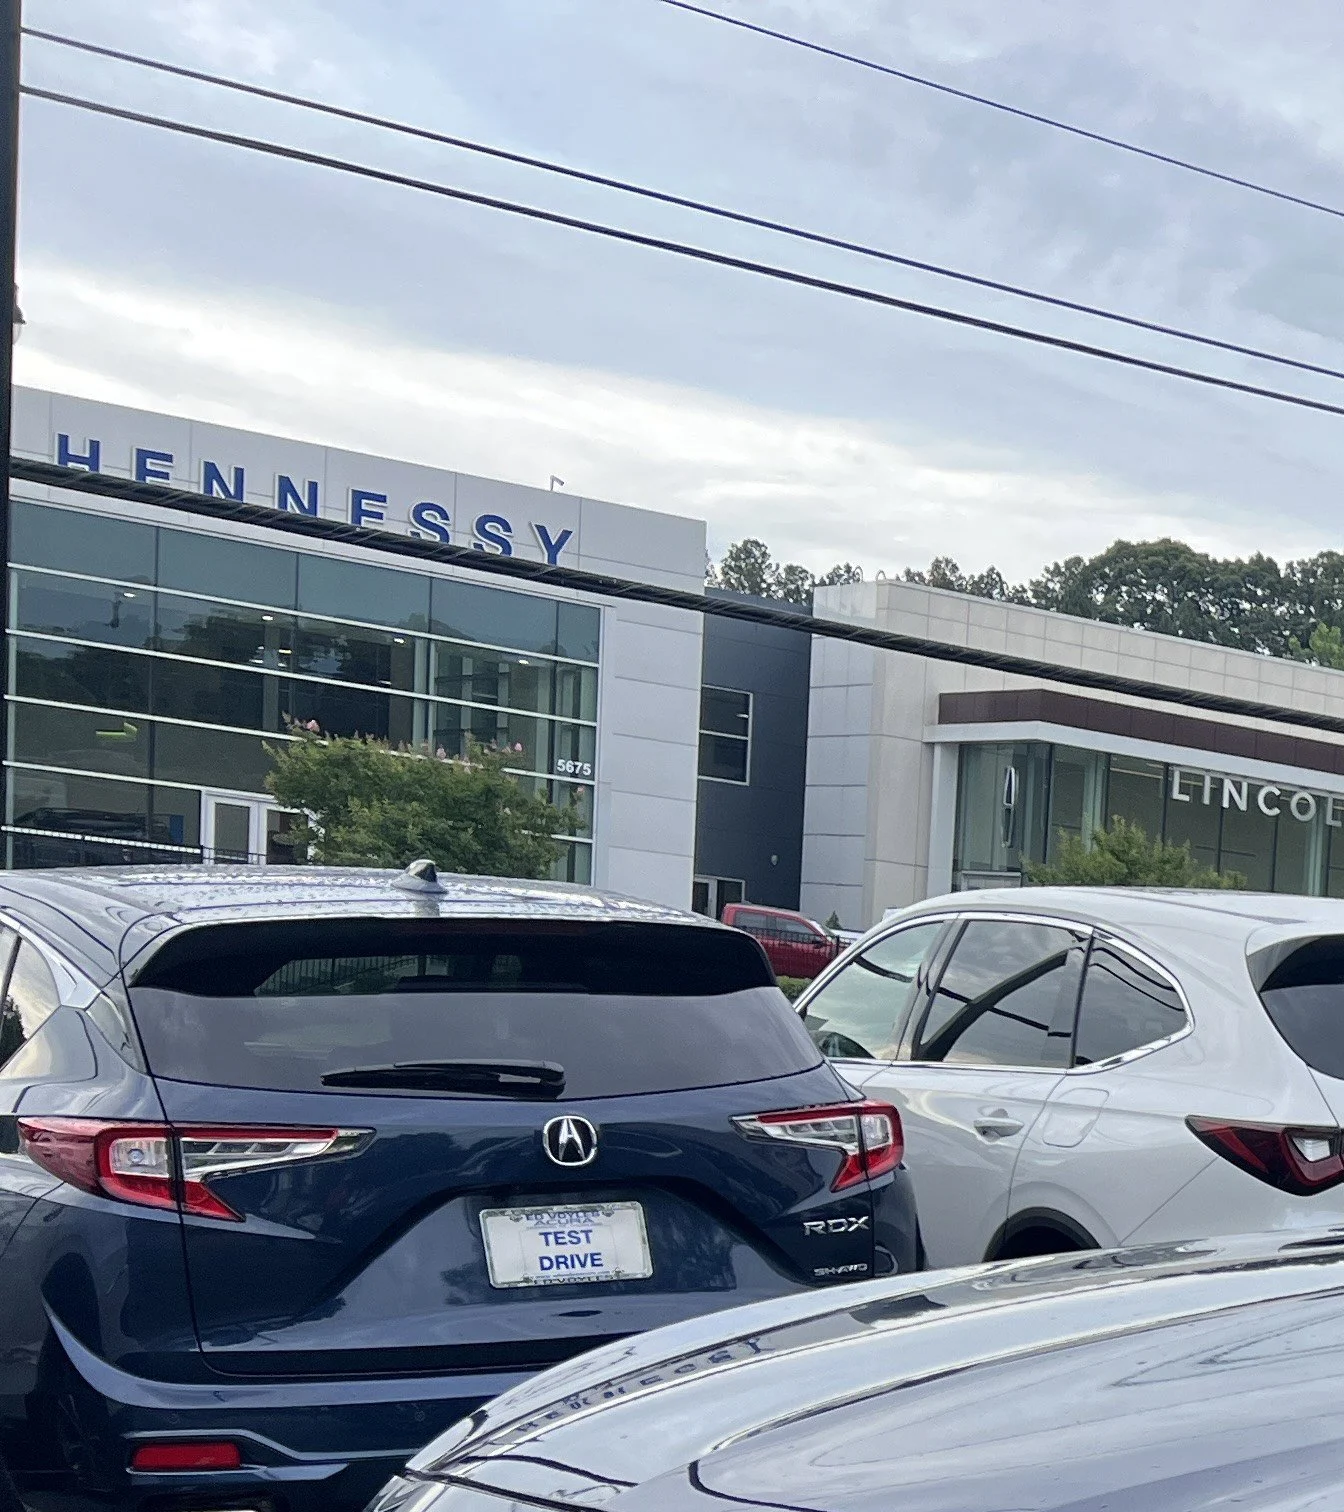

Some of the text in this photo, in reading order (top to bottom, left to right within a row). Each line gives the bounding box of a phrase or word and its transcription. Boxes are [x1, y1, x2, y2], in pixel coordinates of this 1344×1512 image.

[56, 432, 575, 566] HENNESSY
[556, 758, 592, 776] 5675
[803, 1215, 869, 1236] RDX
[539, 1229, 593, 1247] TEST
[539, 1252, 603, 1271] DRIVE
